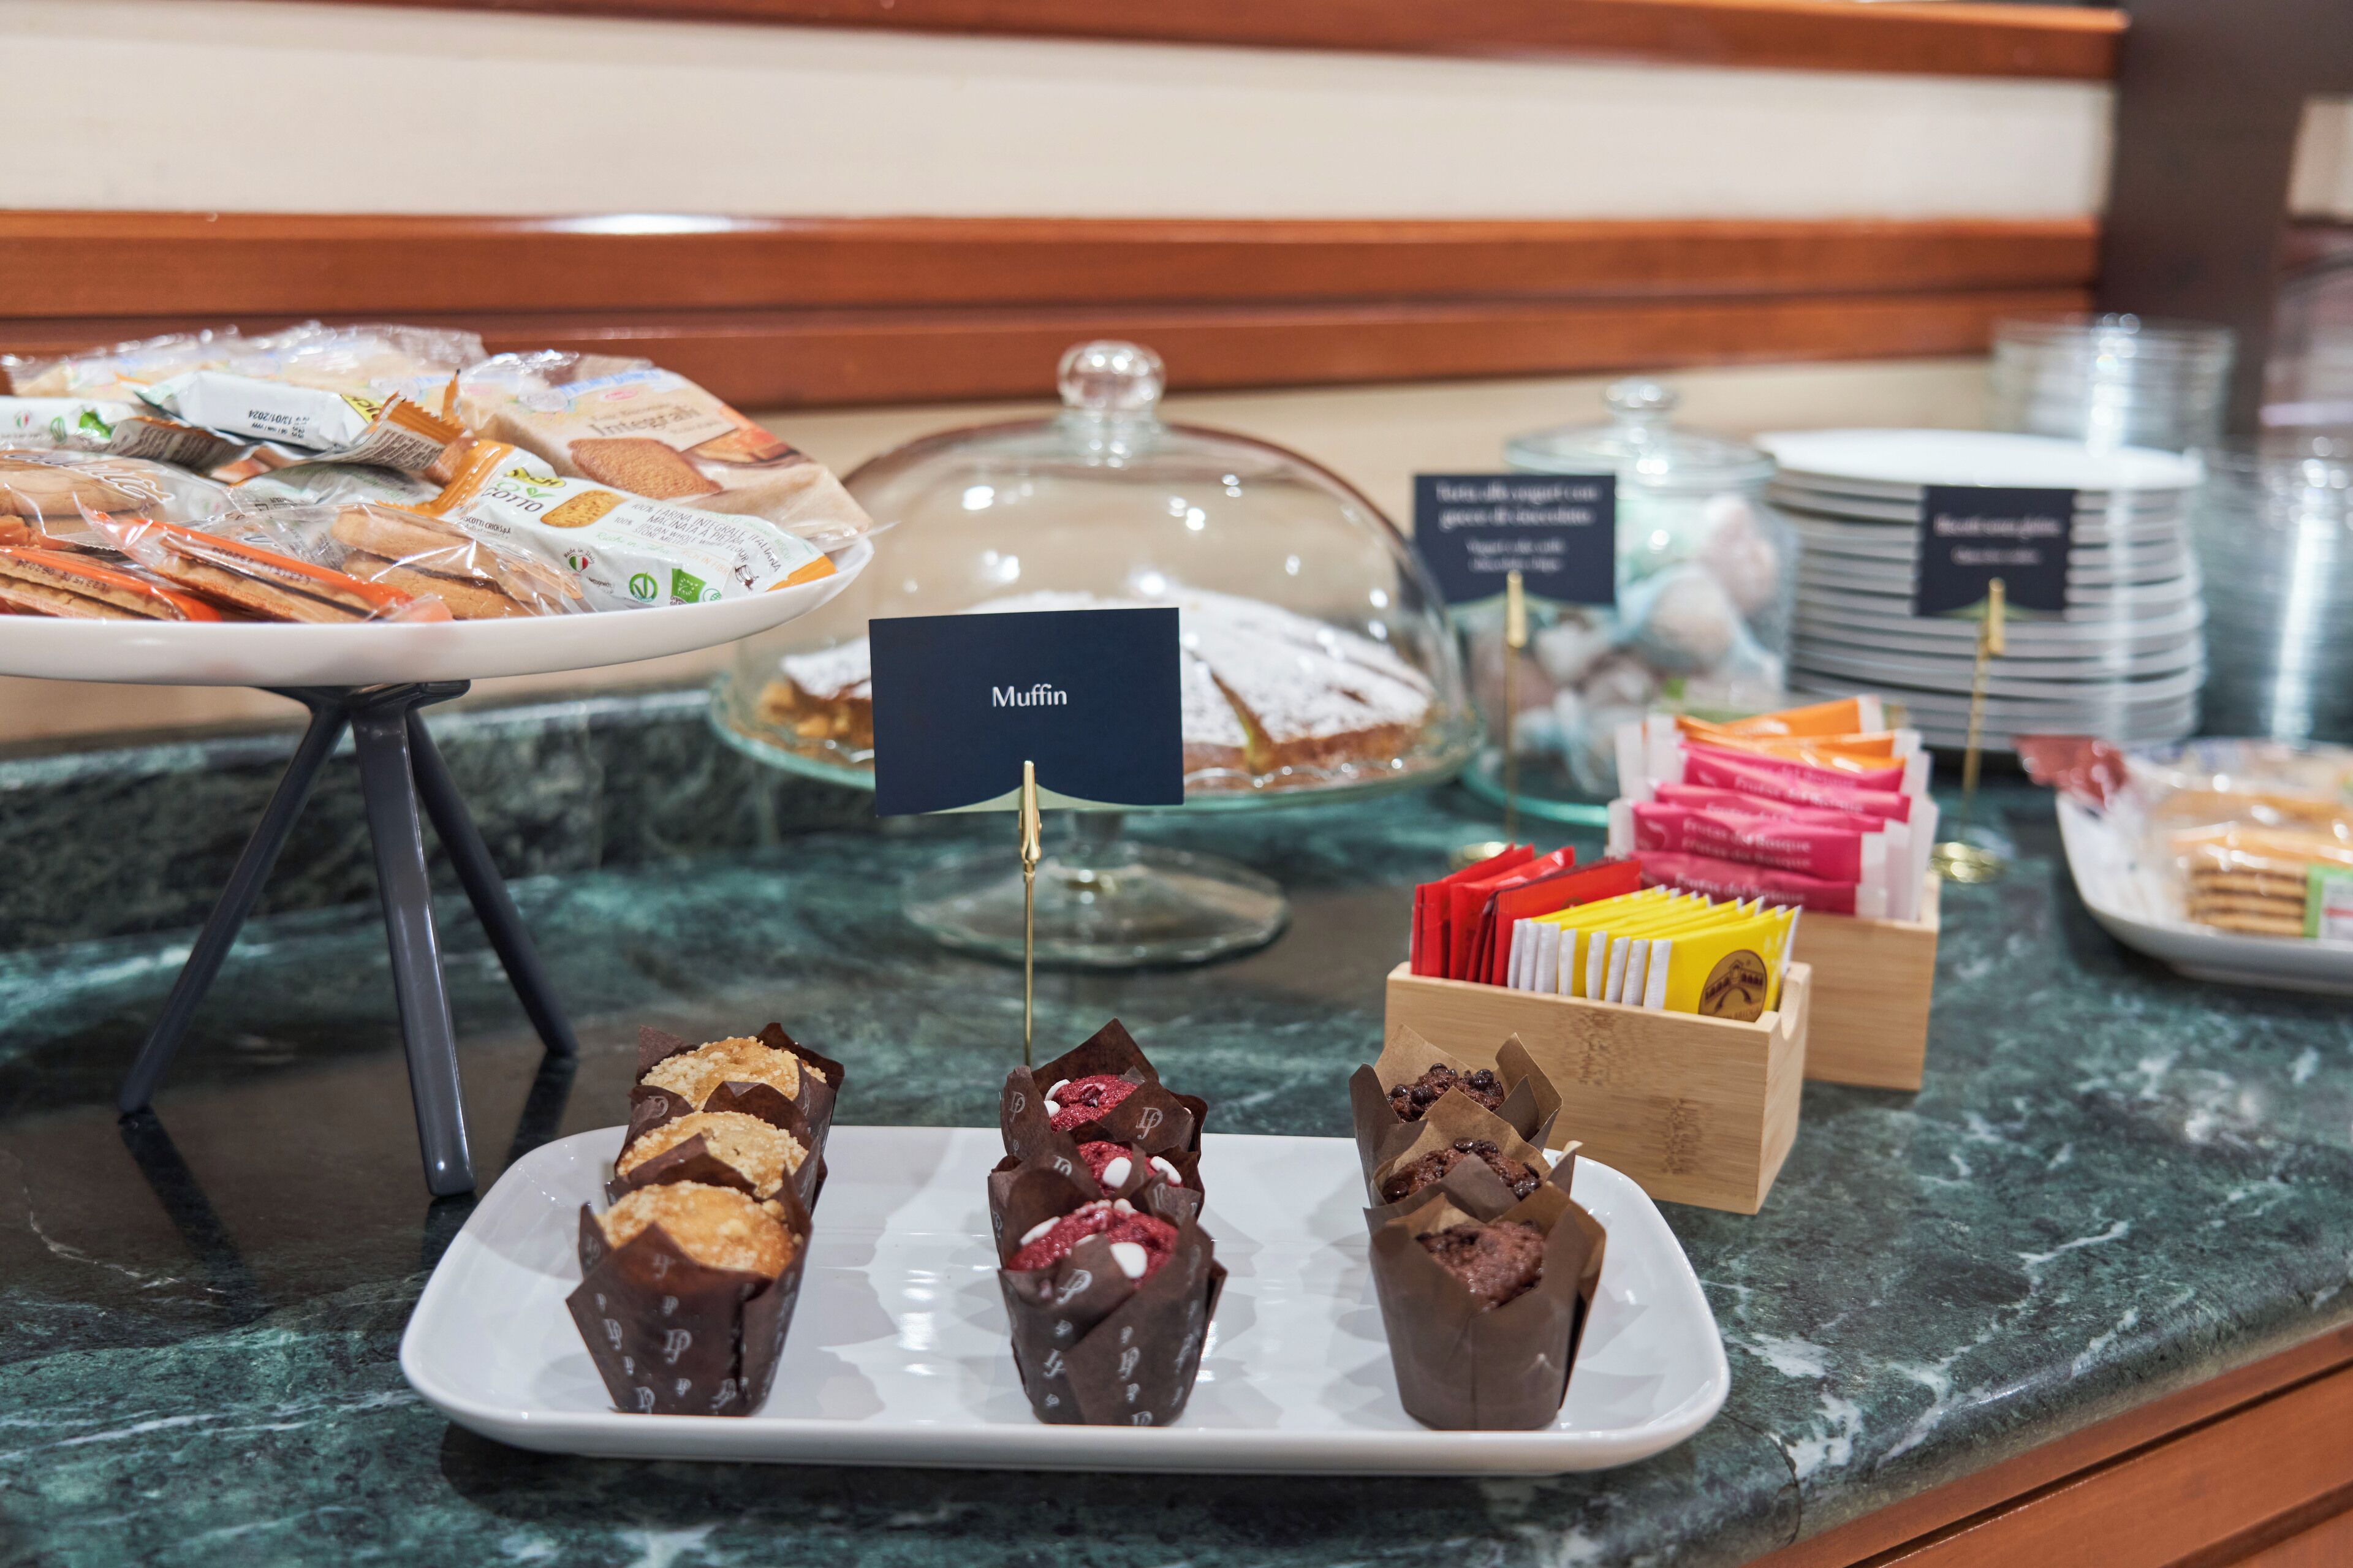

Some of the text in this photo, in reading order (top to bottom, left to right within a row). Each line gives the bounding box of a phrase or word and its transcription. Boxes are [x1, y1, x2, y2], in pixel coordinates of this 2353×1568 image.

[248, 409, 292, 425] 13/01/2024
[646, 515, 699, 534] MACINATA
[991, 683, 1067, 708] Muffin
